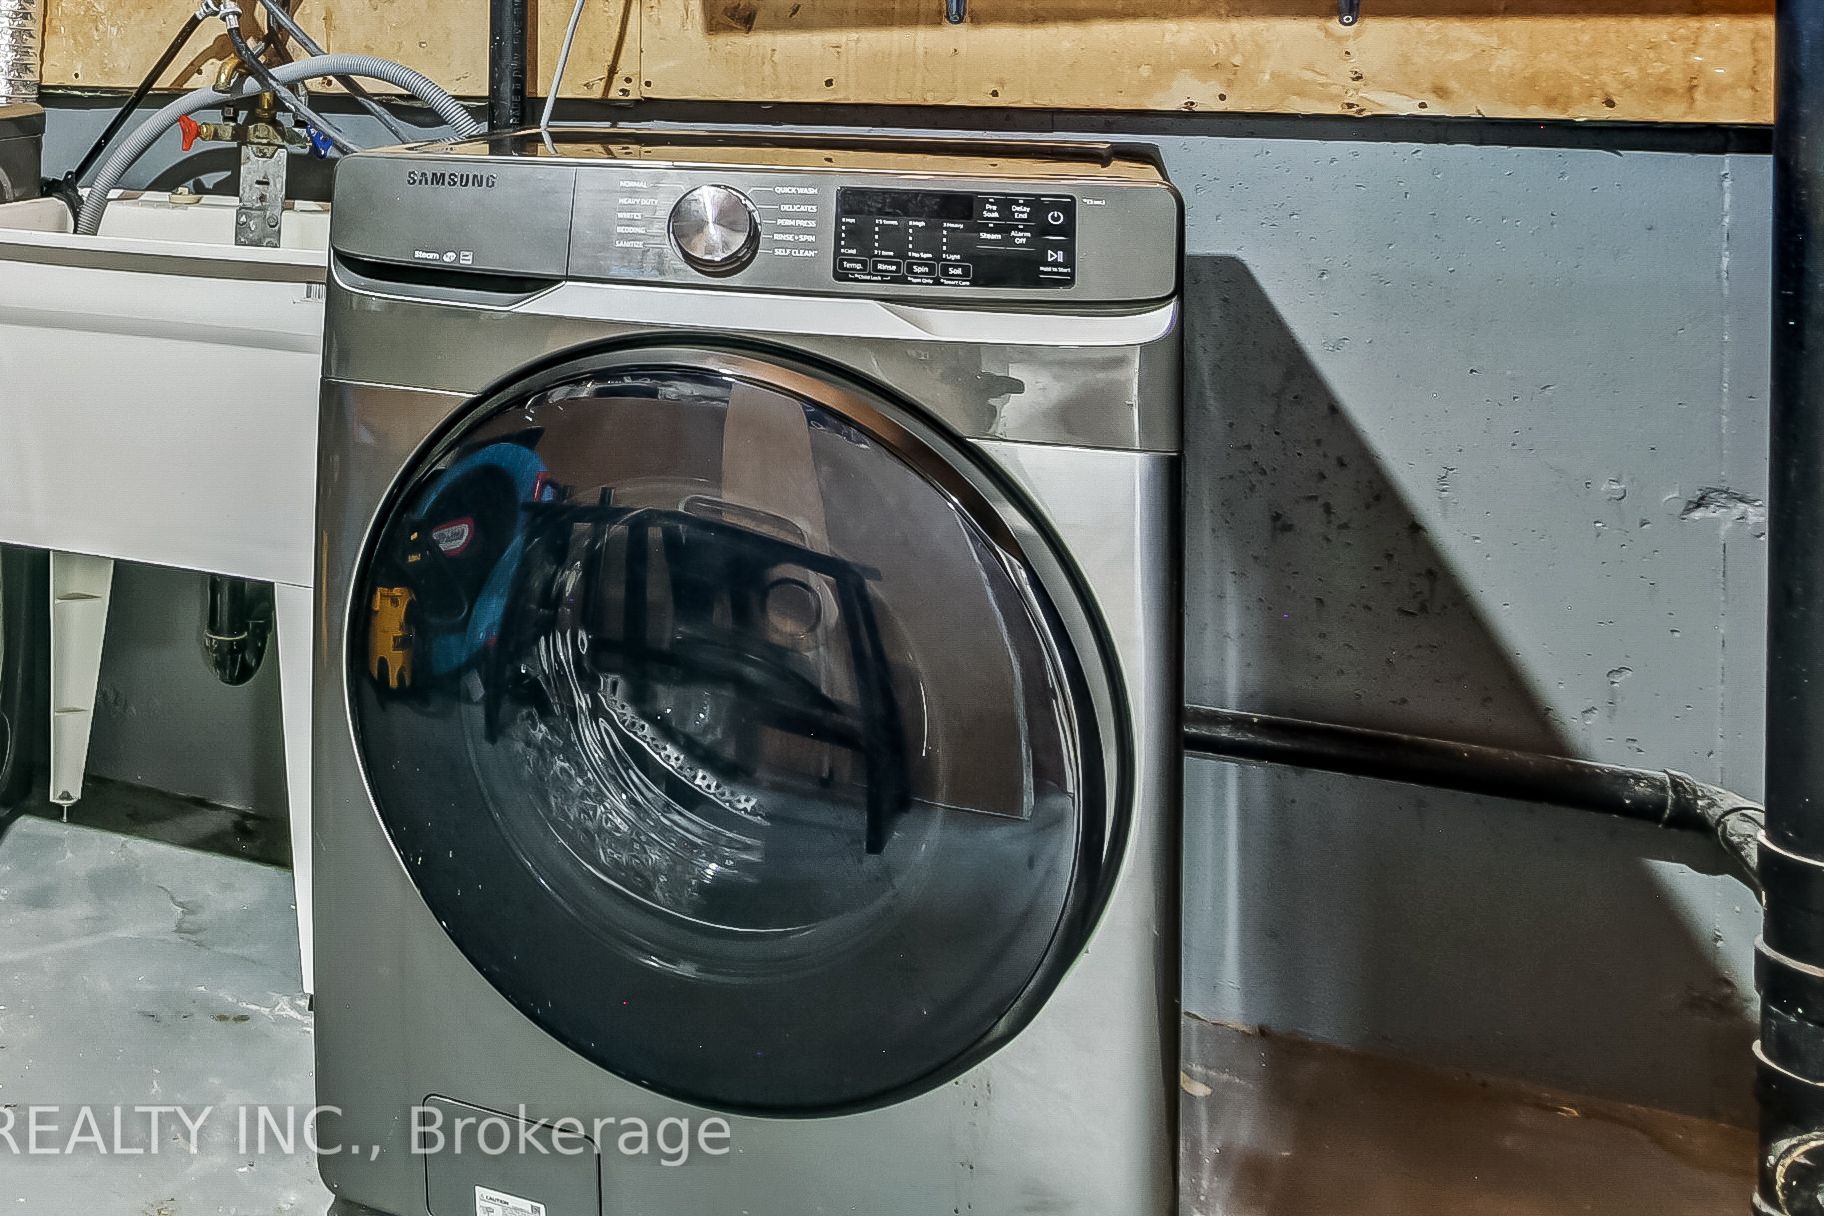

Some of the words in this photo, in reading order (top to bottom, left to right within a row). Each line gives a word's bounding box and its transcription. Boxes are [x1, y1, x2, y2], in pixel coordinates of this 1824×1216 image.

[407, 170, 497, 189] SAMSUNG
[774, 186, 797, 195] QUICK
[797, 187, 818, 195] WASH
[618, 197, 641, 205] HEAVY
[780, 204, 818, 213] DELICATES
[1011, 205, 1030, 213] Delay
[776, 218, 796, 227] PERM
[796, 219, 817, 228] PRESS
[414, 250, 440, 260] Steam
[774, 248, 792, 256] SELF
[913, 265, 929, 273] Spin
[948, 267, 962, 275] Soil
[485, 1195, 509, 1205] CAUTION
